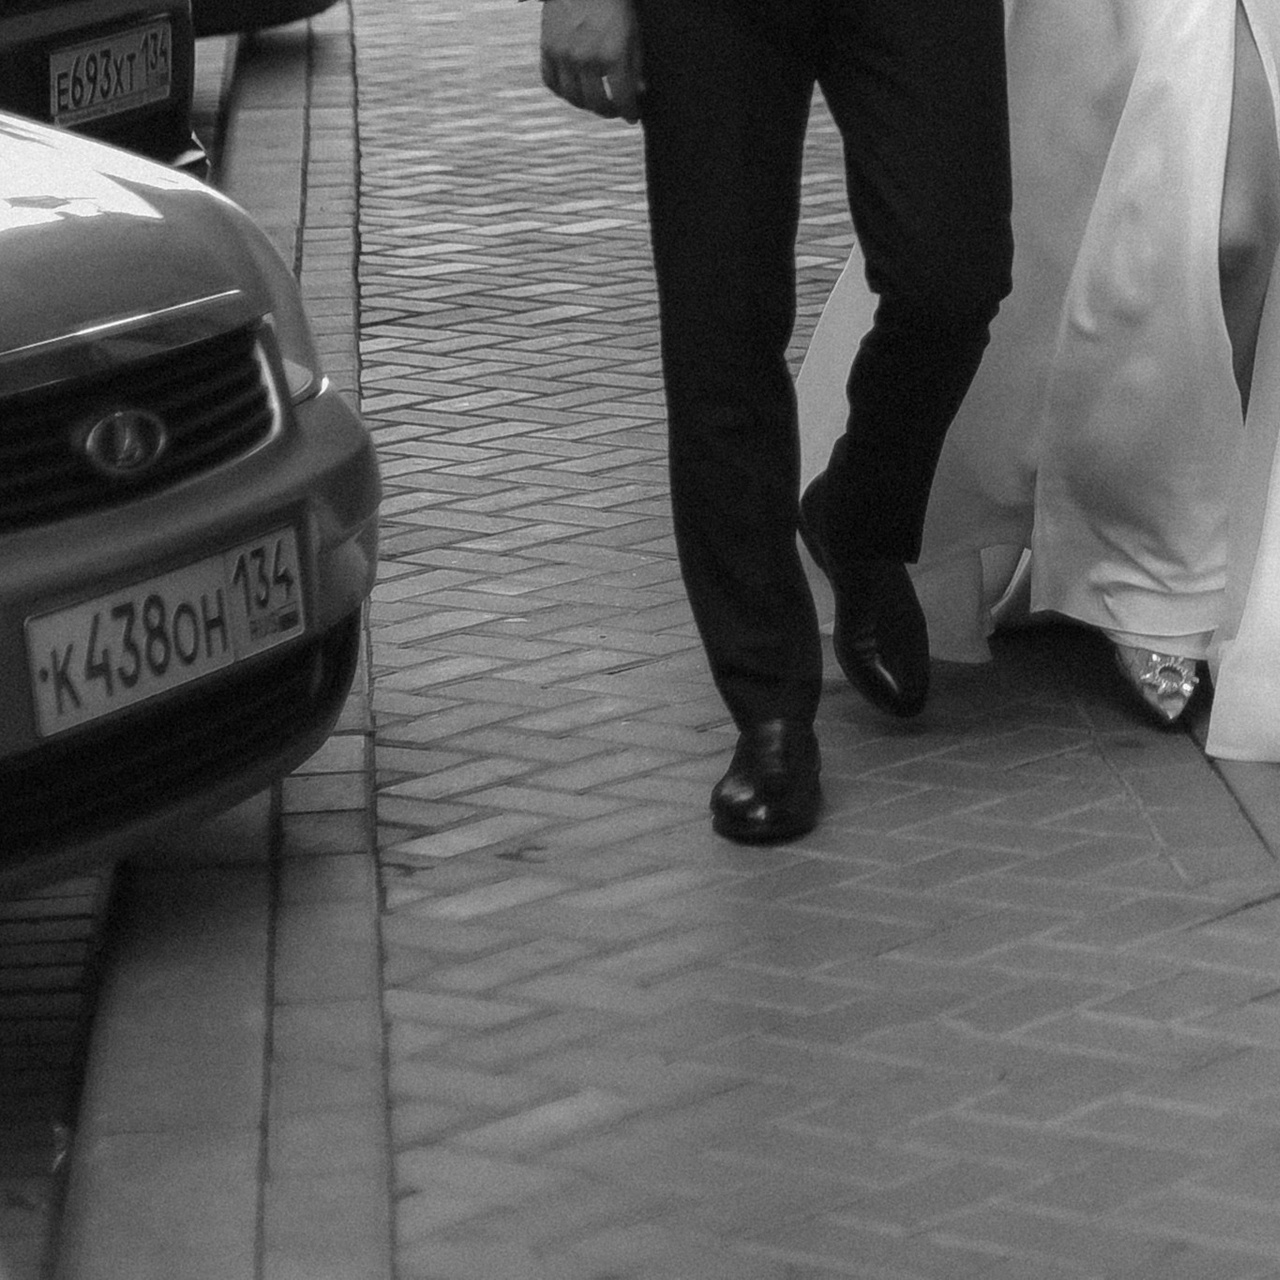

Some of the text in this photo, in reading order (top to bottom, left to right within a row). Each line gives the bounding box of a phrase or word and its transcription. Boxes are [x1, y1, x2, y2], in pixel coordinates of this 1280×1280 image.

[57, 49, 137, 112] Е693ХТ
[51, 539, 294, 716] К438ОН 134
